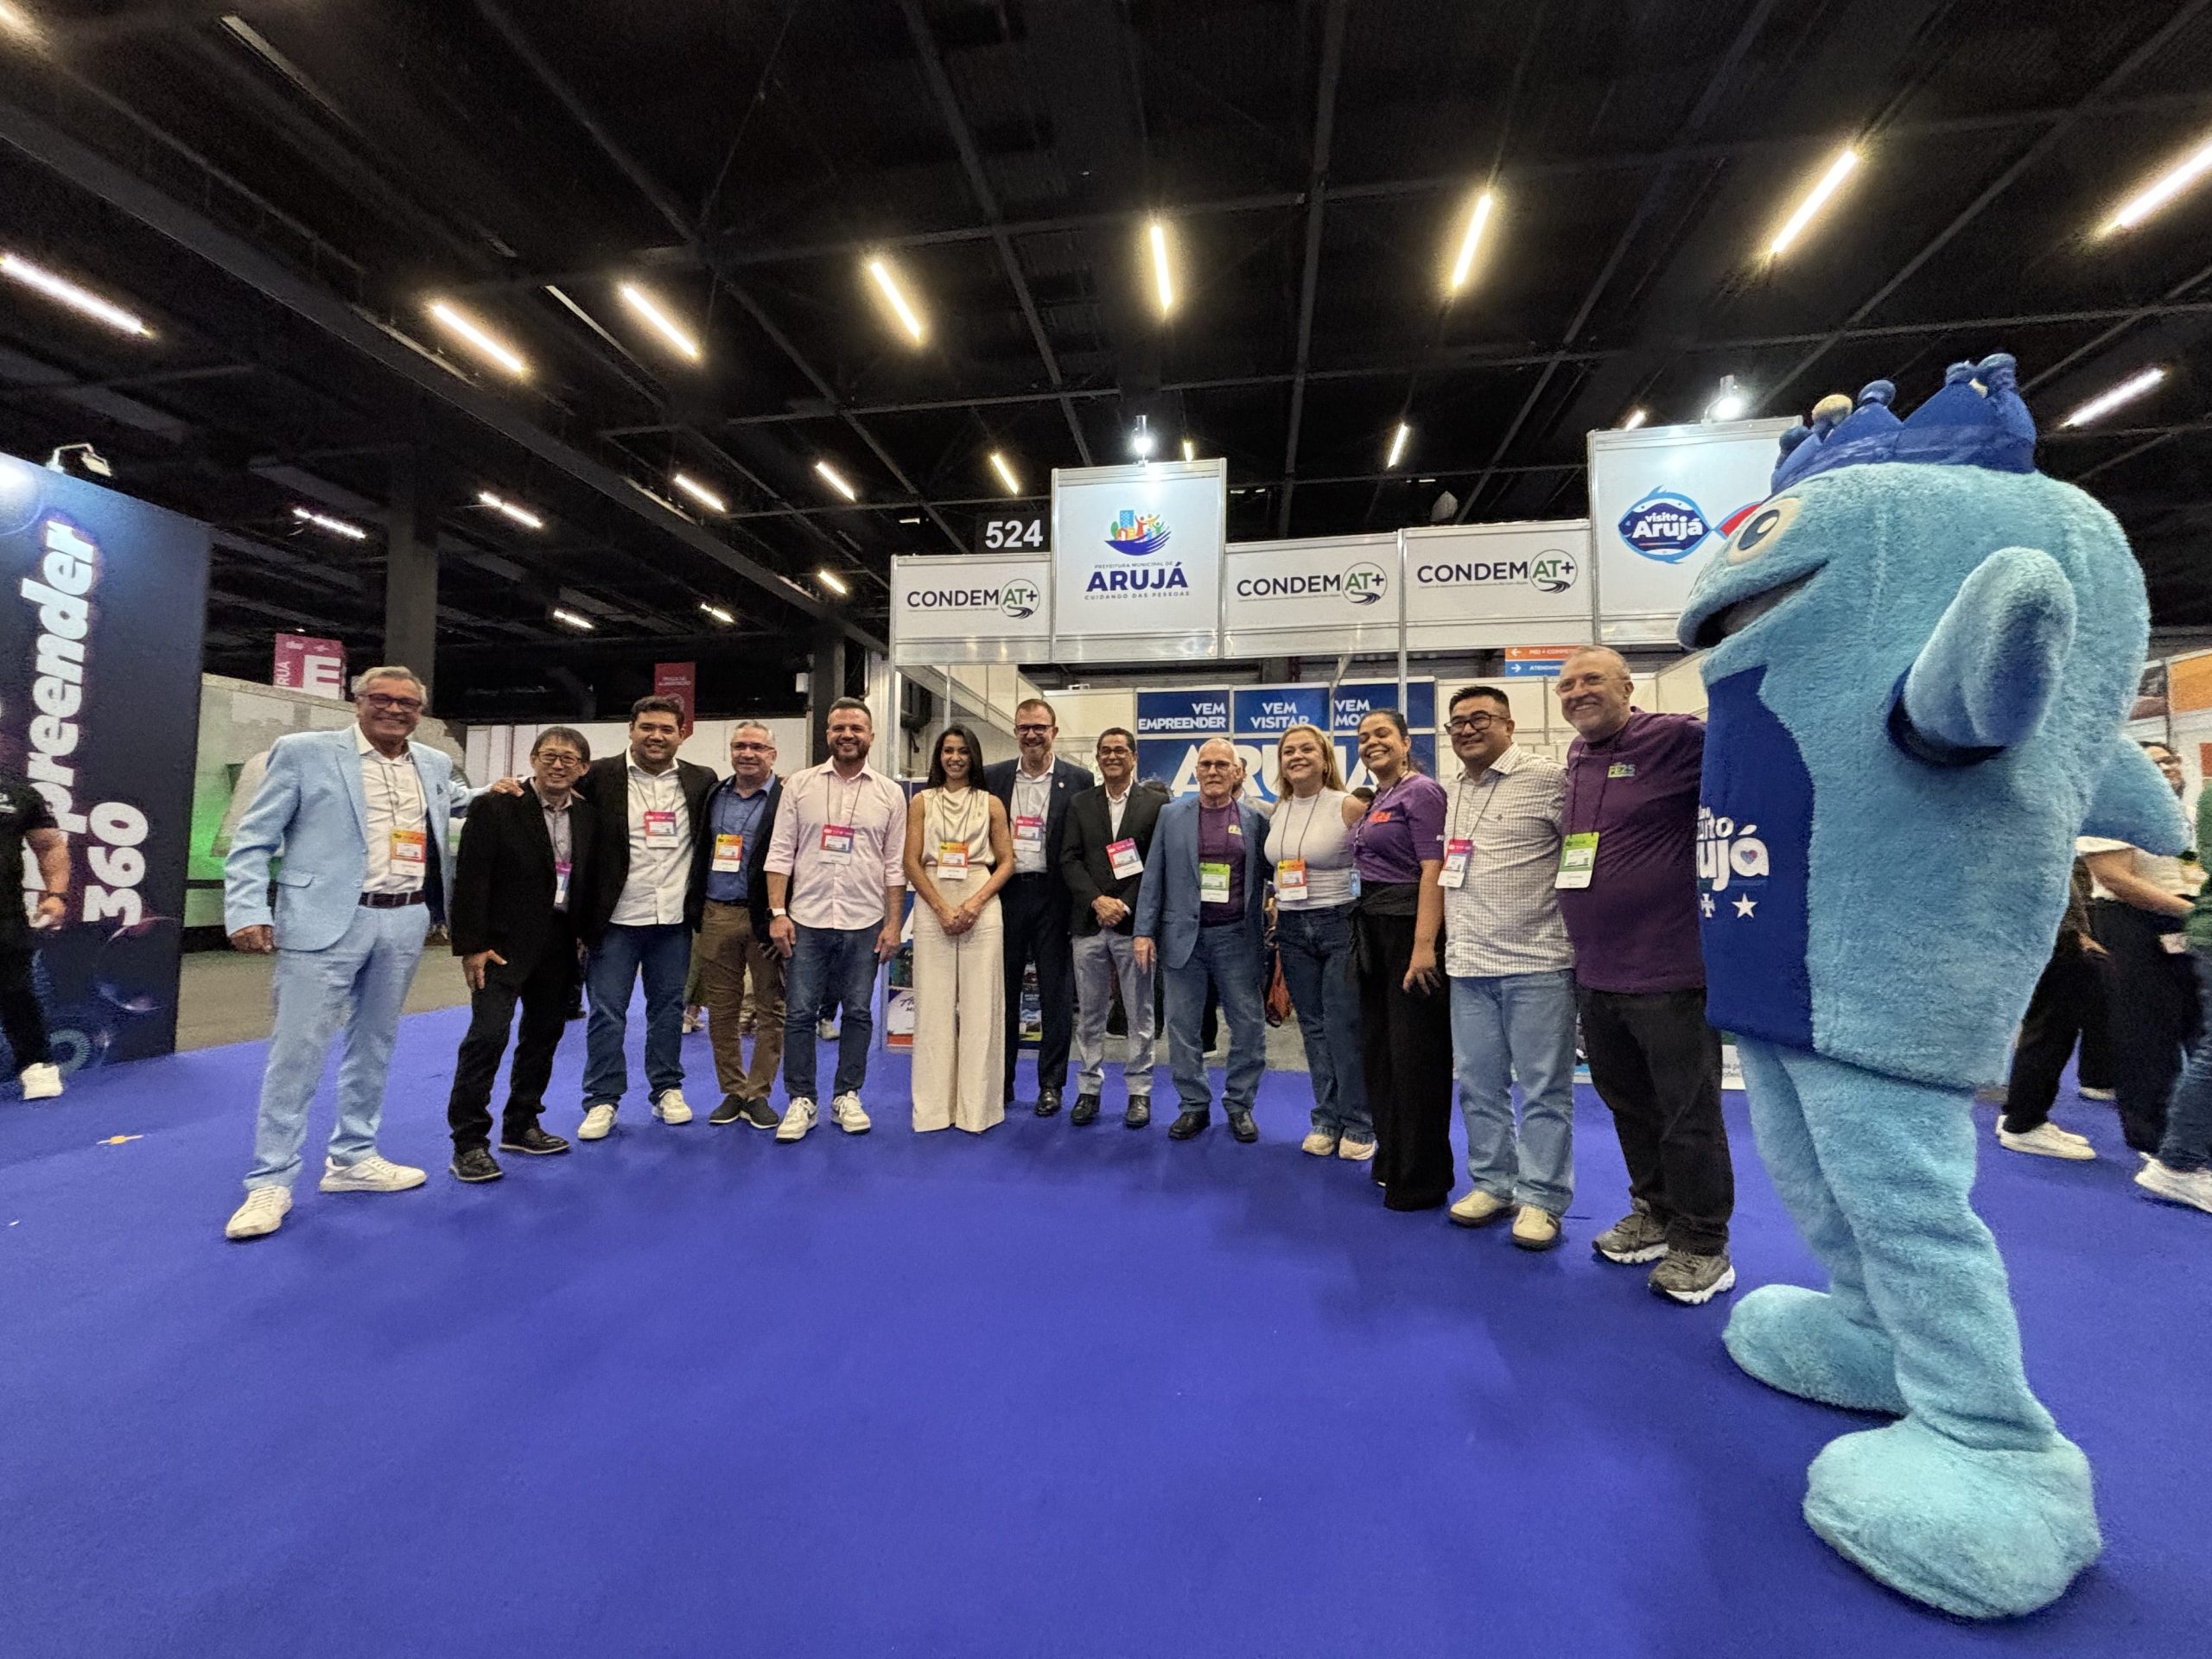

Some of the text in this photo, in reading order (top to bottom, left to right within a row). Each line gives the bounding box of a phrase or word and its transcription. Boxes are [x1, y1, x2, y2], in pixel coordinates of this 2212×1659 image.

[1632, 516, 1703, 541] Arujá
[1645, 512, 1679, 522] visite
[985, 519, 1044, 549] 524
[1086, 562, 1188, 592] ARUJÁ
[276, 661, 291, 686] RUA
[303, 654, 342, 700] E
[1192, 702, 1226, 715] VEM
[1262, 702, 1297, 715] VEM
[1334, 699, 1370, 712] VEM
[21, 520, 93, 921] preender
[1138, 716, 1226, 730] EMPREENDER
[1334, 713, 1363, 727] MO
[82, 802, 149, 926] 360
[1696, 824, 1770, 892] ujá
